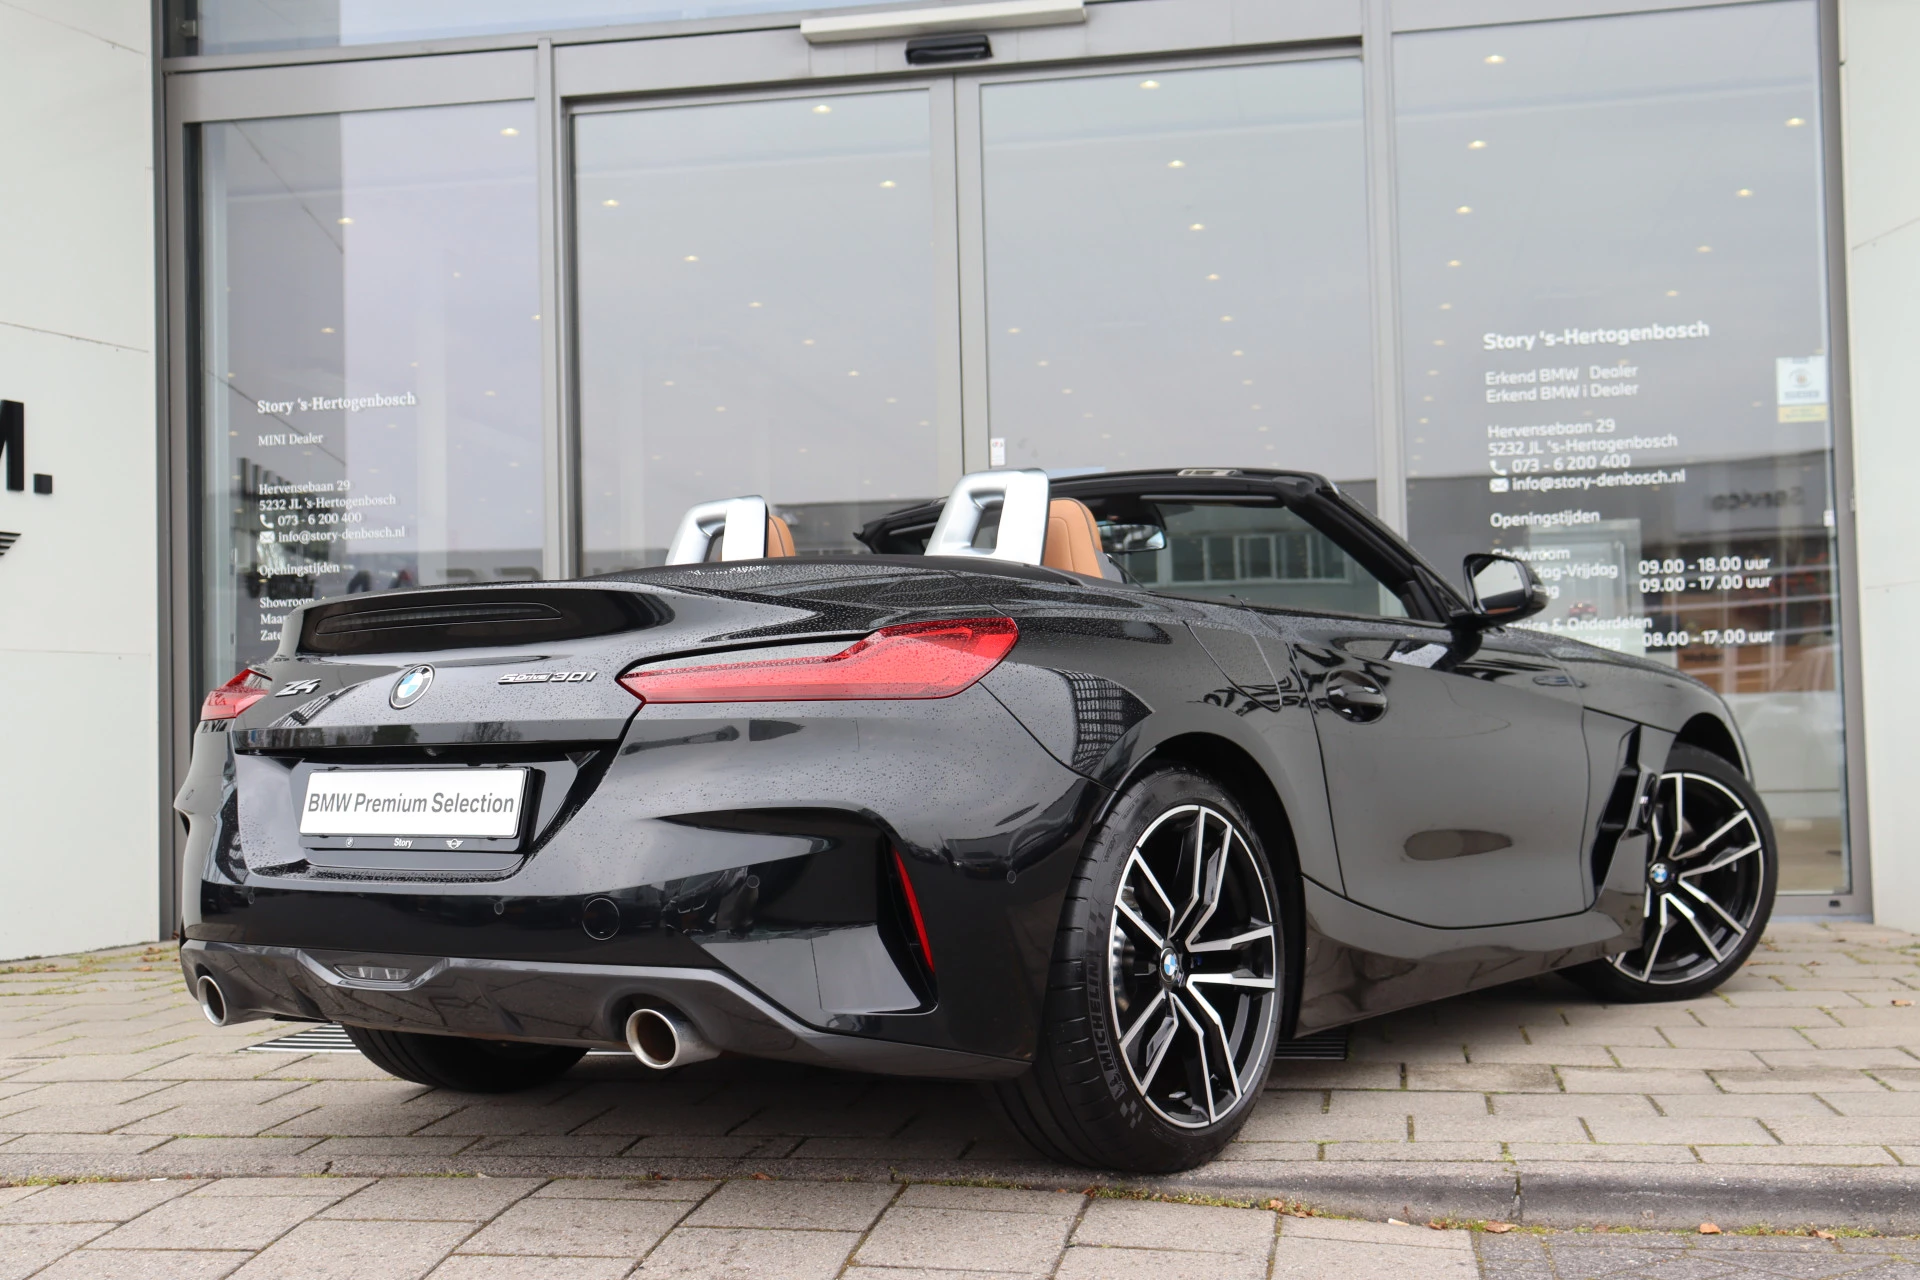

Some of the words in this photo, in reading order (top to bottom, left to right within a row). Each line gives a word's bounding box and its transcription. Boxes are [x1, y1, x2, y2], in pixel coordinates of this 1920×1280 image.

[1483, 332, 1535, 351] Story
[1539, 320, 1710, 346] 's-Hertogenbosch
[1485, 369, 1536, 386] Erkend
[1539, 367, 1579, 383] BMW
[1589, 364, 1639, 380] Dealer
[1486, 387, 1537, 403] Erkend
[1540, 385, 1580, 400] BMW
[1582, 384, 1587, 398] i
[1590, 382, 1639, 398] Dealer
[257, 399, 294, 415] Story
[297, 391, 417, 412] 's-Hertogenbosch
[1487, 422, 1593, 438] Hervensebaan
[1596, 418, 1616, 433] 29
[258, 433, 285, 447] MINI
[289, 432, 323, 445] Dealer
[1488, 441, 1525, 456] 5232
[1527, 440, 1544, 455] JL
[1547, 433, 1678, 454] 's-Hertogenbosch
[1511, 458, 1540, 473] 073
[1553, 457, 1563, 471] 6
[1567, 455, 1597, 470] 200
[1600, 453, 1631, 468] 400
[258, 481, 334, 495] Hervensebaan
[337, 479, 351, 492] 29
[1512, 468, 1686, 492] info@story-denbosch.nl
[259, 498, 286, 511] 5232
[288, 498, 302, 510] JL
[304, 493, 396, 510] 's-Hertogenbosch
[277, 514, 299, 527] 073
[307, 514, 316, 525] 6
[318, 513, 339, 525] 200
[341, 512, 362, 524] 400
[1490, 509, 1600, 529] Openingstijden
[278, 526, 406, 545] info@story-denbosch.nl
[259, 563, 341, 578] Openingstijden
[1536, 563, 1618, 581] dag-Vrijdag
[1638, 558, 1685, 575] 09.00
[1697, 556, 1742, 572] 18.00
[1744, 557, 1771, 571] uur
[1639, 577, 1686, 593] 09.00
[1745, 576, 1772, 589] uur
[1552, 617, 1564, 630] &
[1567, 615, 1653, 631] Onderdelen
[1642, 631, 1689, 647] 08.00
[1701, 628, 1745, 645] 17.00
[1748, 630, 1775, 643] uur
[274, 678, 322, 697] Z4
[307, 792, 353, 813] BMW
[353, 792, 428, 813] Premium
[431, 791, 514, 813] Selection
[393, 837, 413, 849] Story
[1087, 960, 1116, 1072] MICHELIN
